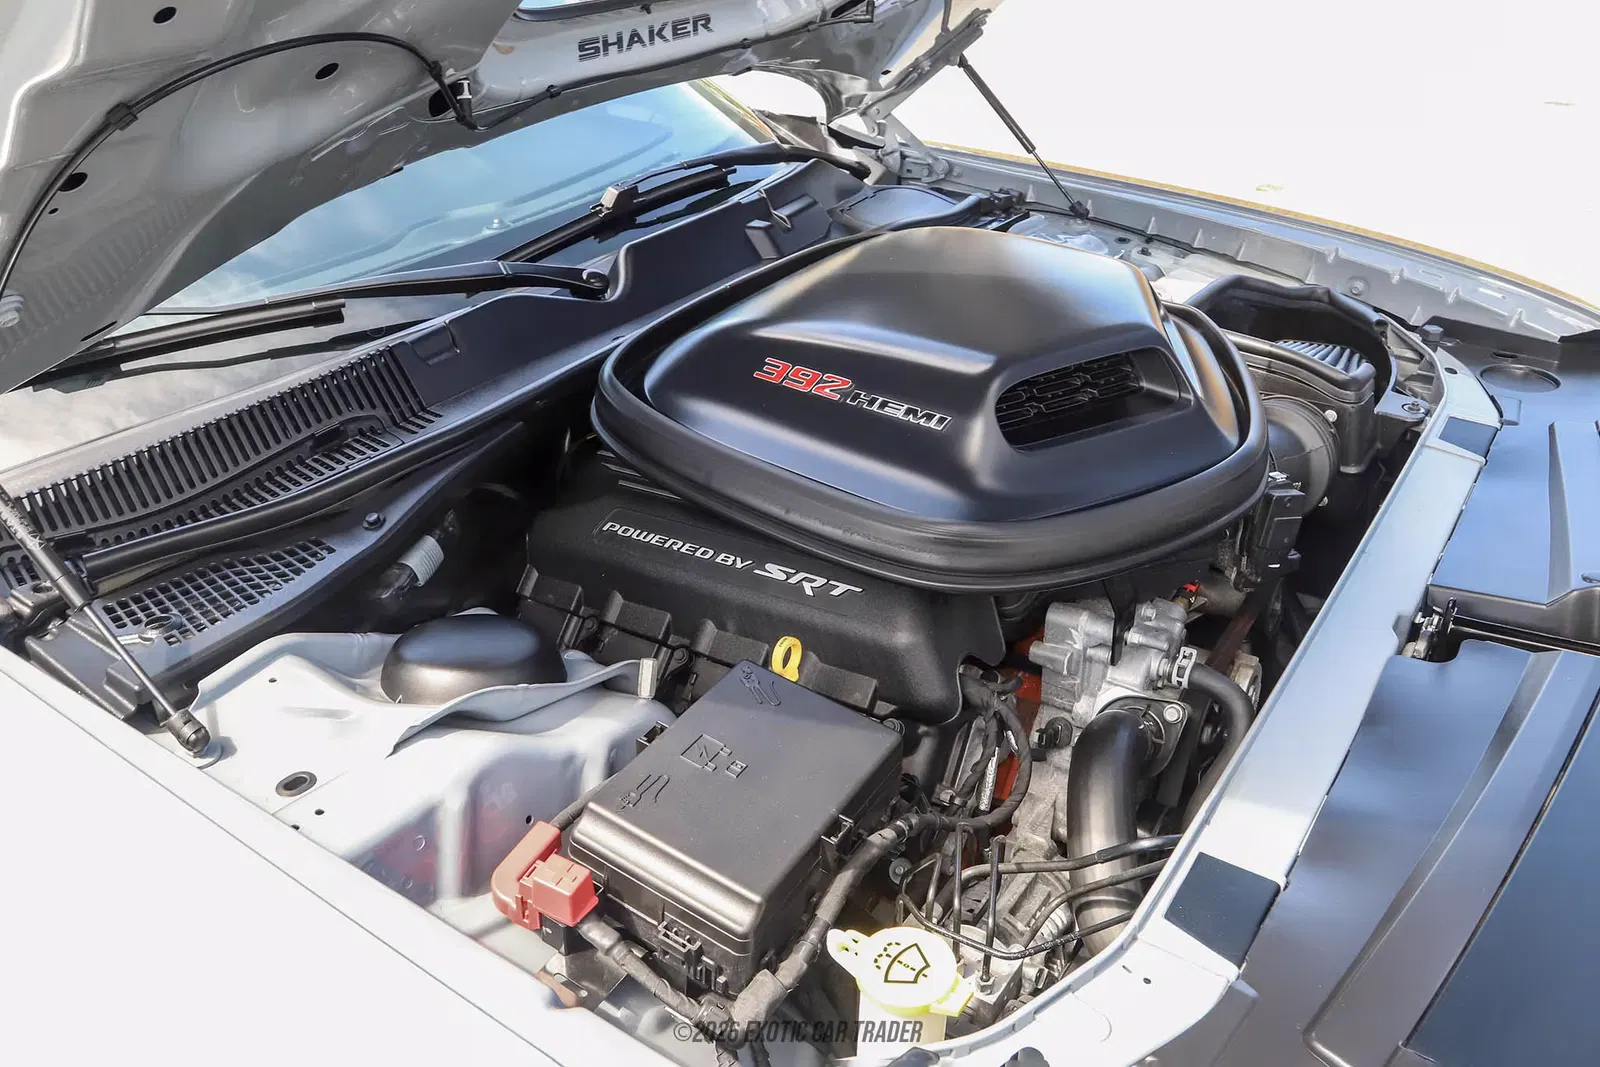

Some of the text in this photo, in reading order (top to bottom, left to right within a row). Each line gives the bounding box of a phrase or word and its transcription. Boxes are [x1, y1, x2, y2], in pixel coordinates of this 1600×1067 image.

[578, 13, 714, 62] SHAKER
[753, 357, 953, 430] 392 HEMI
[602, 521, 864, 597] POWERED BY SRT
